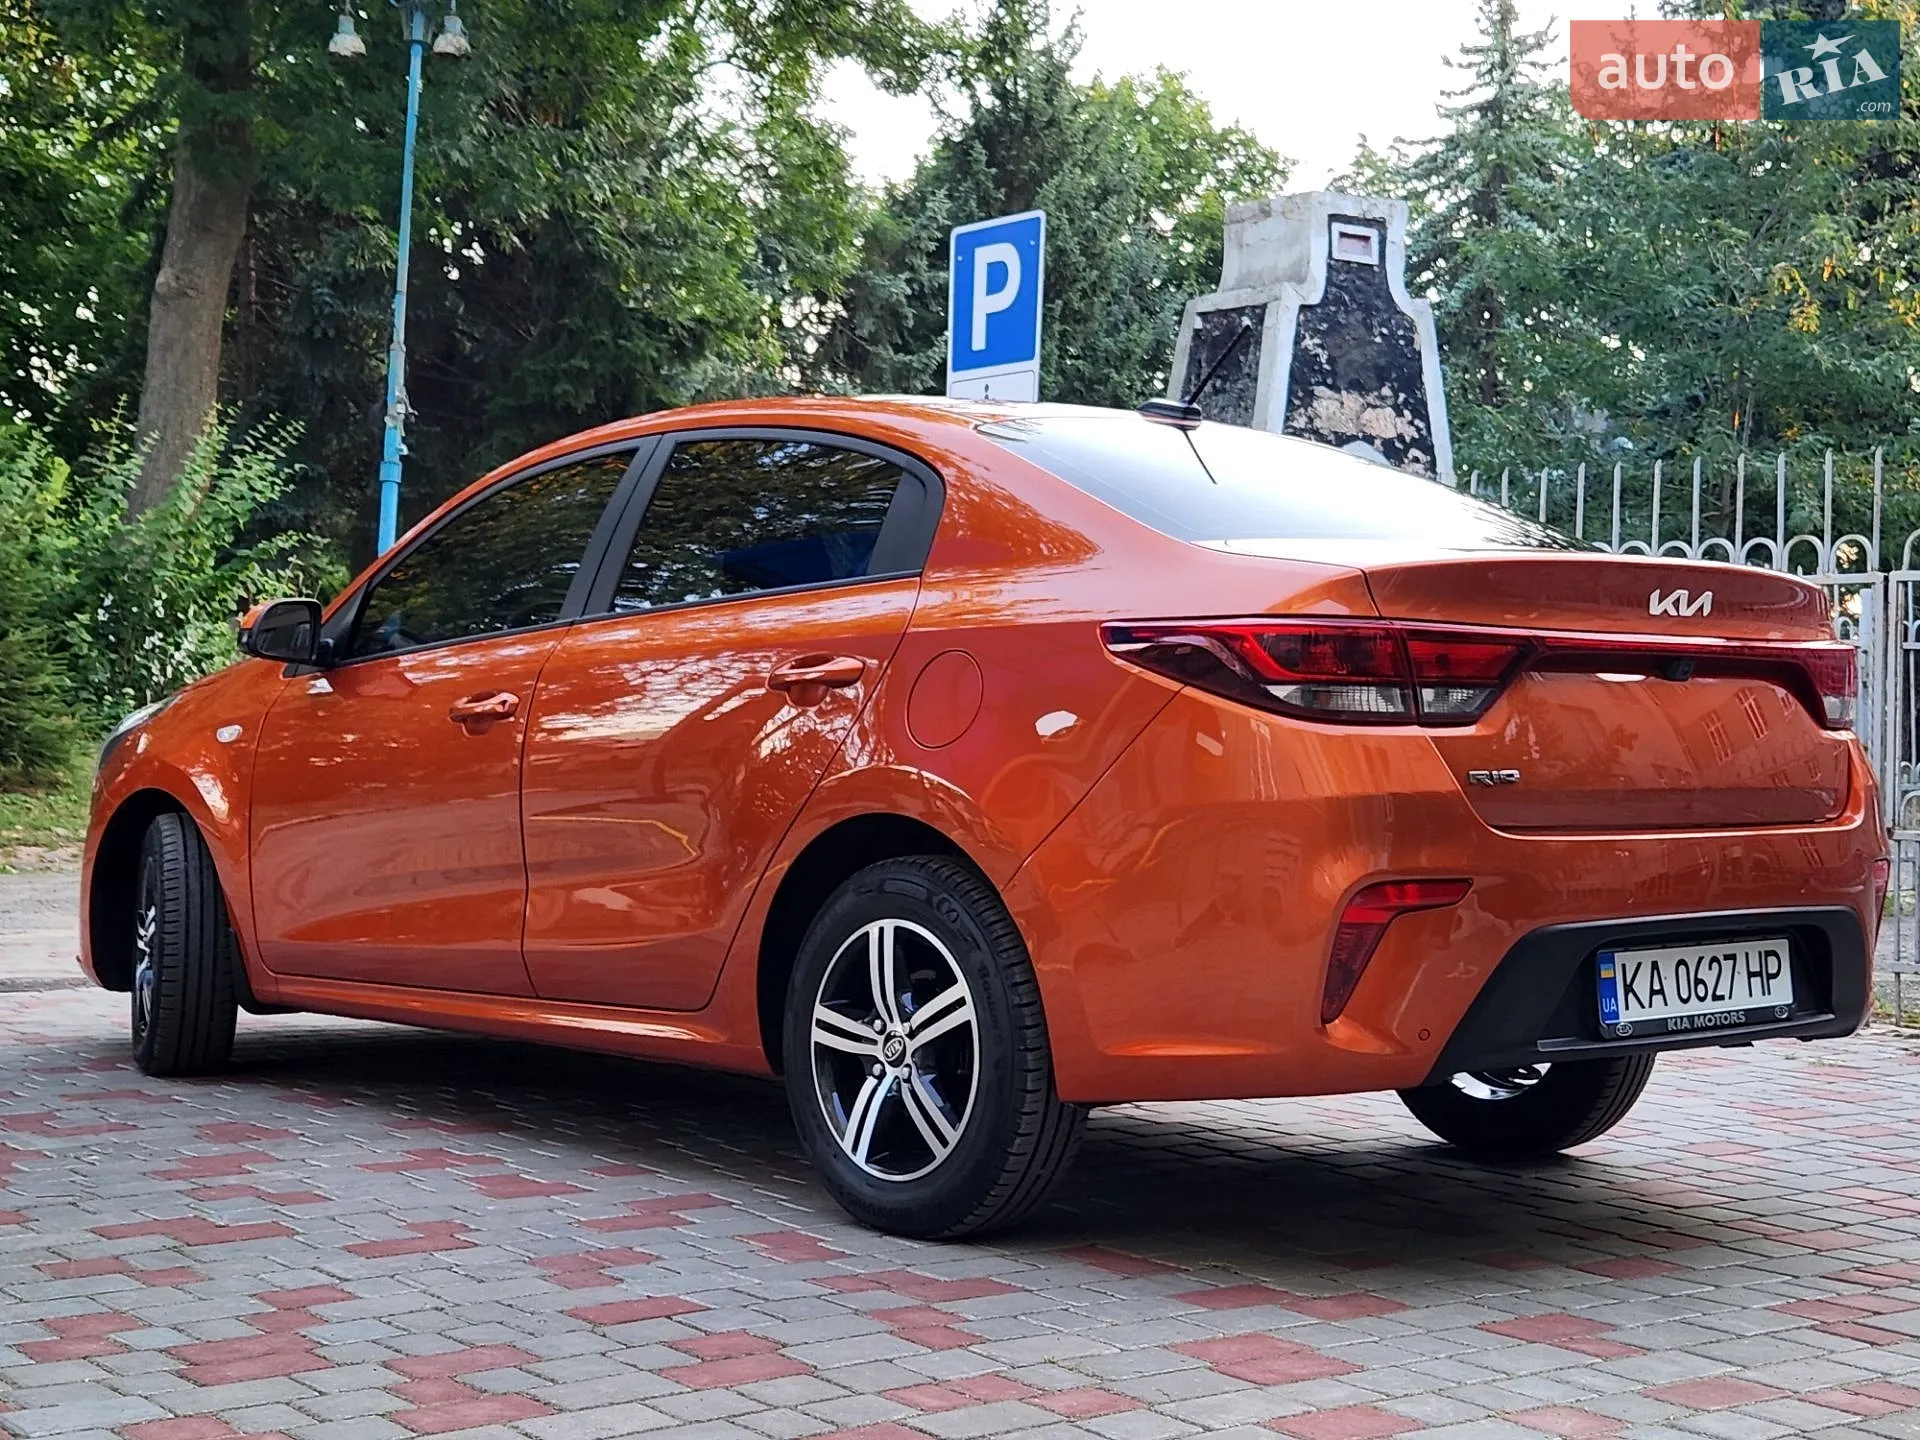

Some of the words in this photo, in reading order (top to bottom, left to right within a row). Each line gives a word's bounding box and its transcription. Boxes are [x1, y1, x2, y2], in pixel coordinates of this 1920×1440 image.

[971, 242, 1021, 352] P
[1649, 588, 1713, 617] KIA
[1468, 769, 1520, 786] RIO
[1621, 960, 1668, 1011] KA
[1674, 952, 1737, 1005] 0627
[1745, 949, 1782, 998] HP
[1602, 997, 1617, 1013] UA
[1667, 1017, 1691, 1031] KIA
[1693, 1011, 1746, 1028] MOTORS
